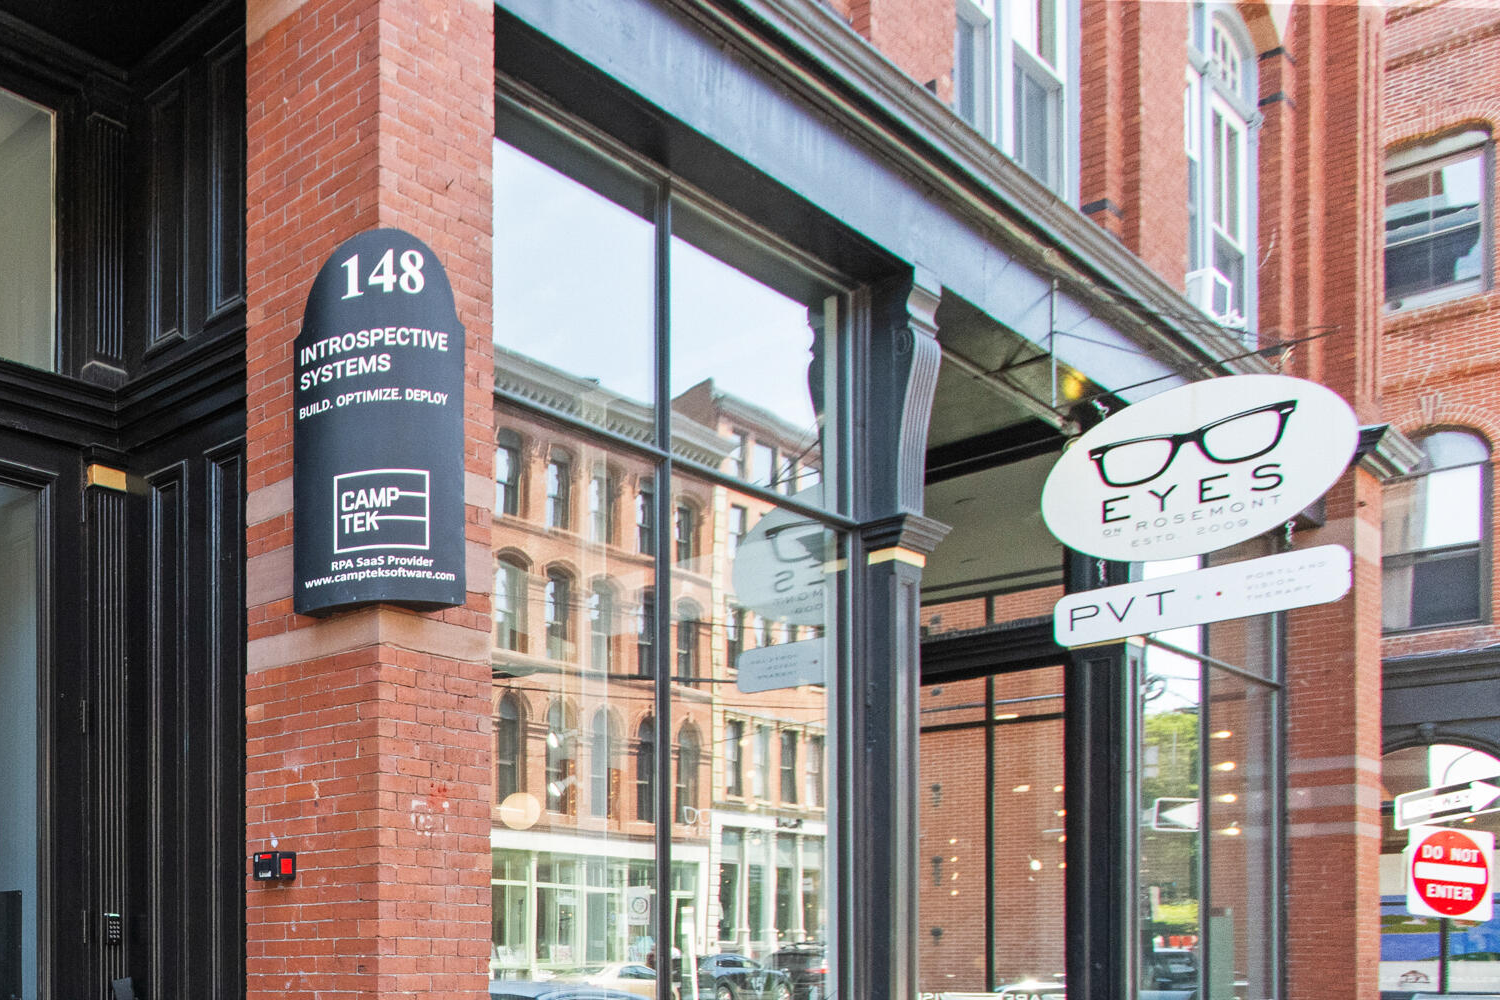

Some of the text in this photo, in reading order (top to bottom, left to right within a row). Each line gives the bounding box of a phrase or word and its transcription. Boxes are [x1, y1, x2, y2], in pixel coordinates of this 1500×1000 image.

[340, 248, 425, 300] 148
[300, 327, 448, 367] INTROSPECTIVE
[300, 353, 391, 391] SYSTEMS
[299, 388, 448, 420] BUILD. OPTIMIZE. DEPLOY
[341, 487, 399, 512] CAMP
[1101, 464, 1284, 524] EYES
[341, 510, 379, 534] TEK
[1136, 494, 1281, 531] ROSEMONT
[1196, 518, 1249, 535] 2009
[305, 567, 455, 589] www.campteksoftware.com
[331, 556, 434, 572] RPA SaaS Provider
[1070, 589, 1175, 631] PVT
[1421, 845, 1480, 863] DO NOT
[1426, 884, 1474, 901] ENTER
